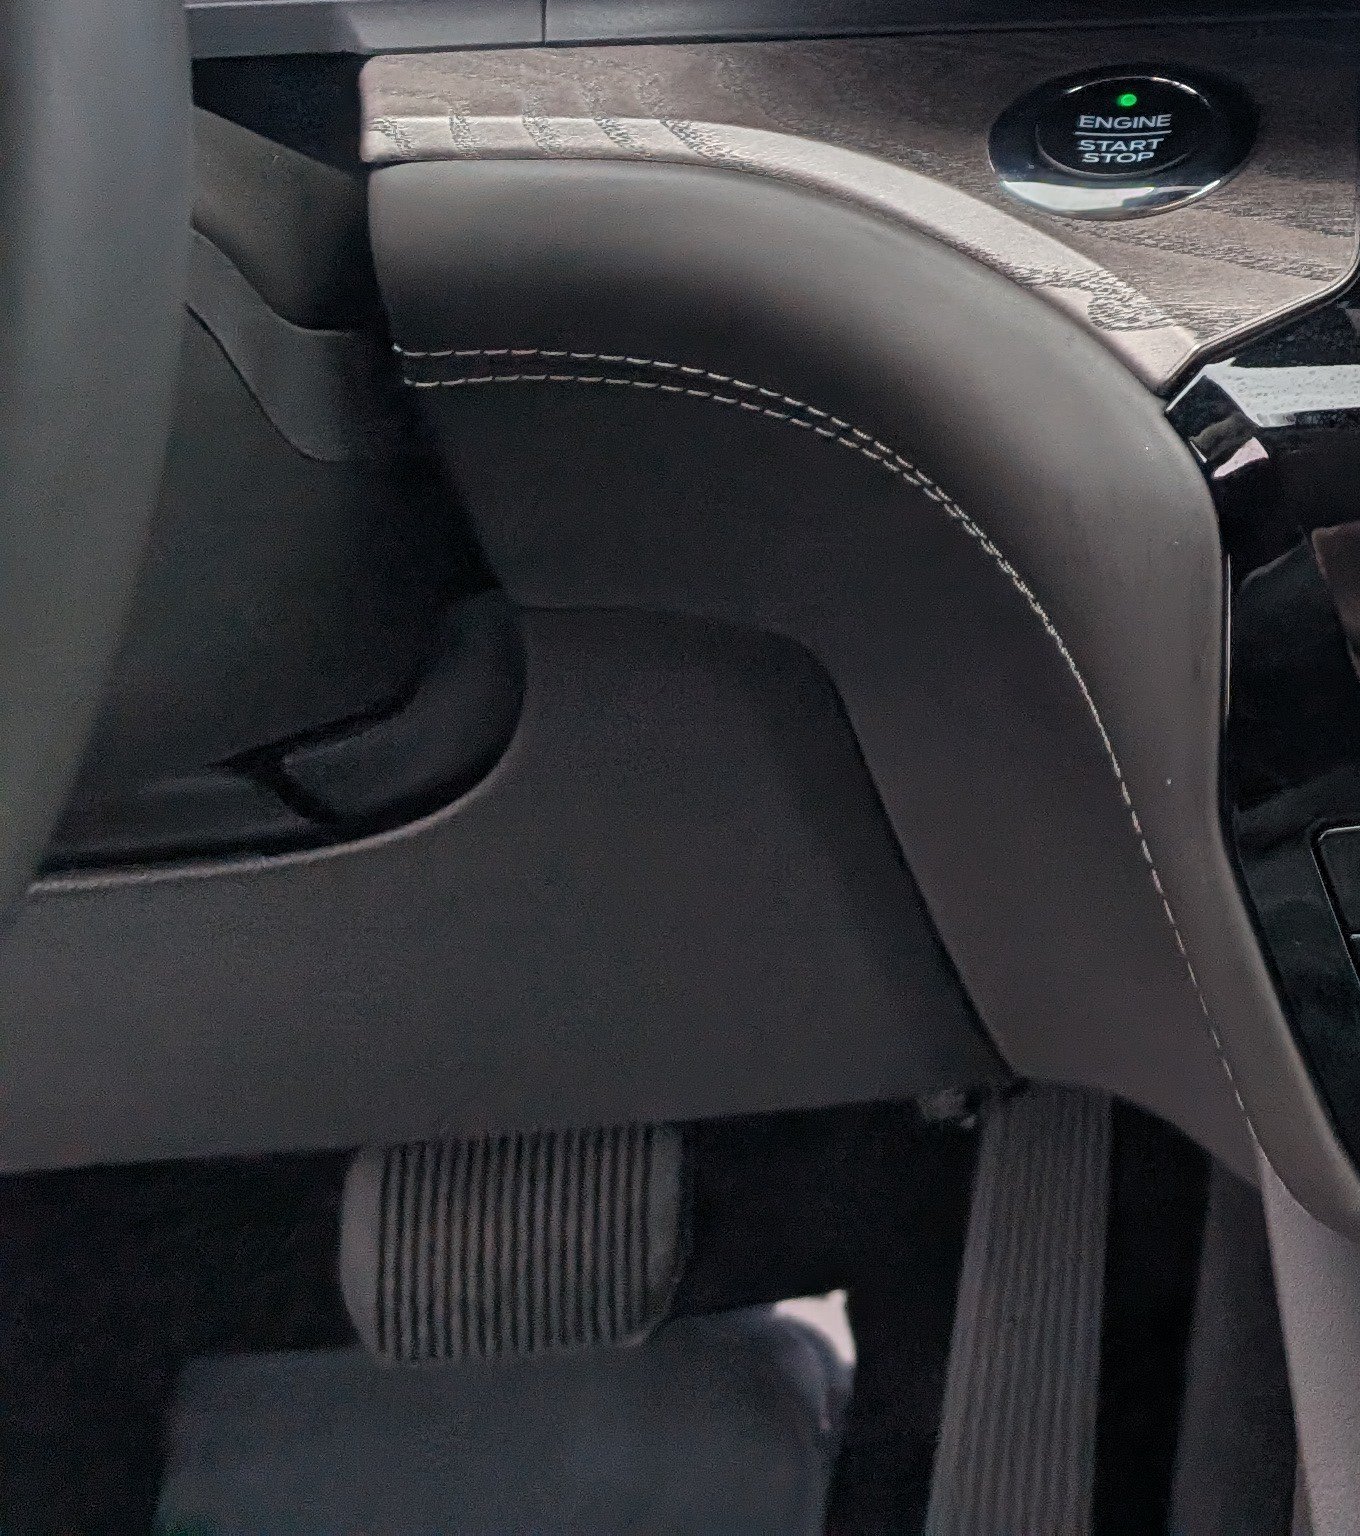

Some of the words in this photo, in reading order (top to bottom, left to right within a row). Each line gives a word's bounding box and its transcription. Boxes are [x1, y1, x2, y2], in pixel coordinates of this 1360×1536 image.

[1079, 115, 1171, 129] ENGINE
[1079, 138, 1164, 151] START
[1082, 152, 1154, 163] STOP
